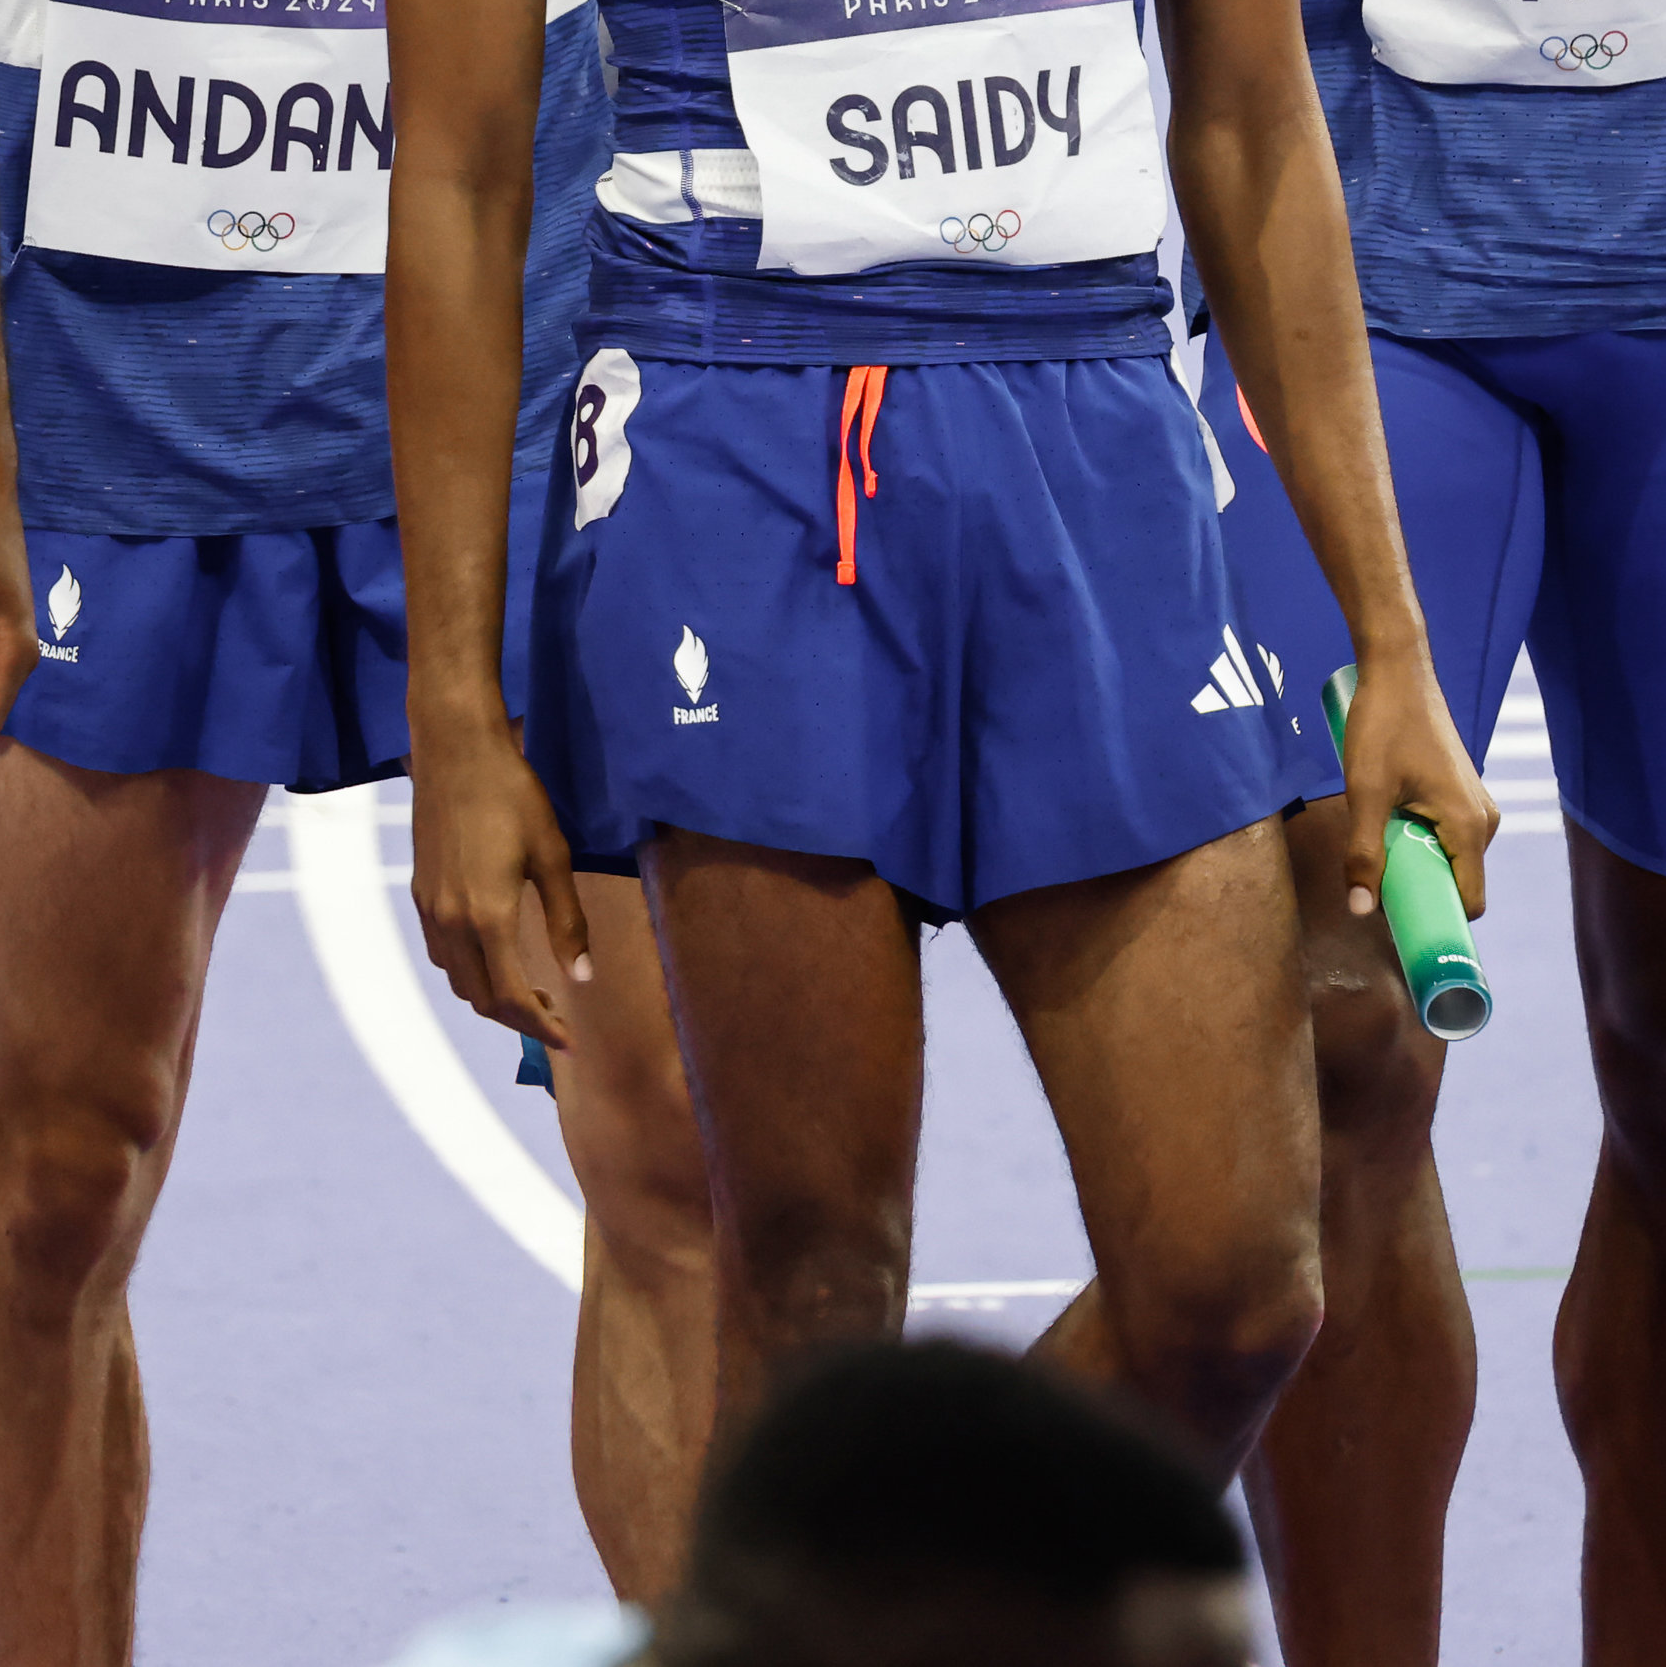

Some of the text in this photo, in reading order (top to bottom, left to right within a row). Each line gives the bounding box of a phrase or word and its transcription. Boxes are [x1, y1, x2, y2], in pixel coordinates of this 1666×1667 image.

[54, 60, 395, 172] ANDAN
[827, 64, 1083, 187] SAIDY
[673, 703, 719, 725] FRANCE
